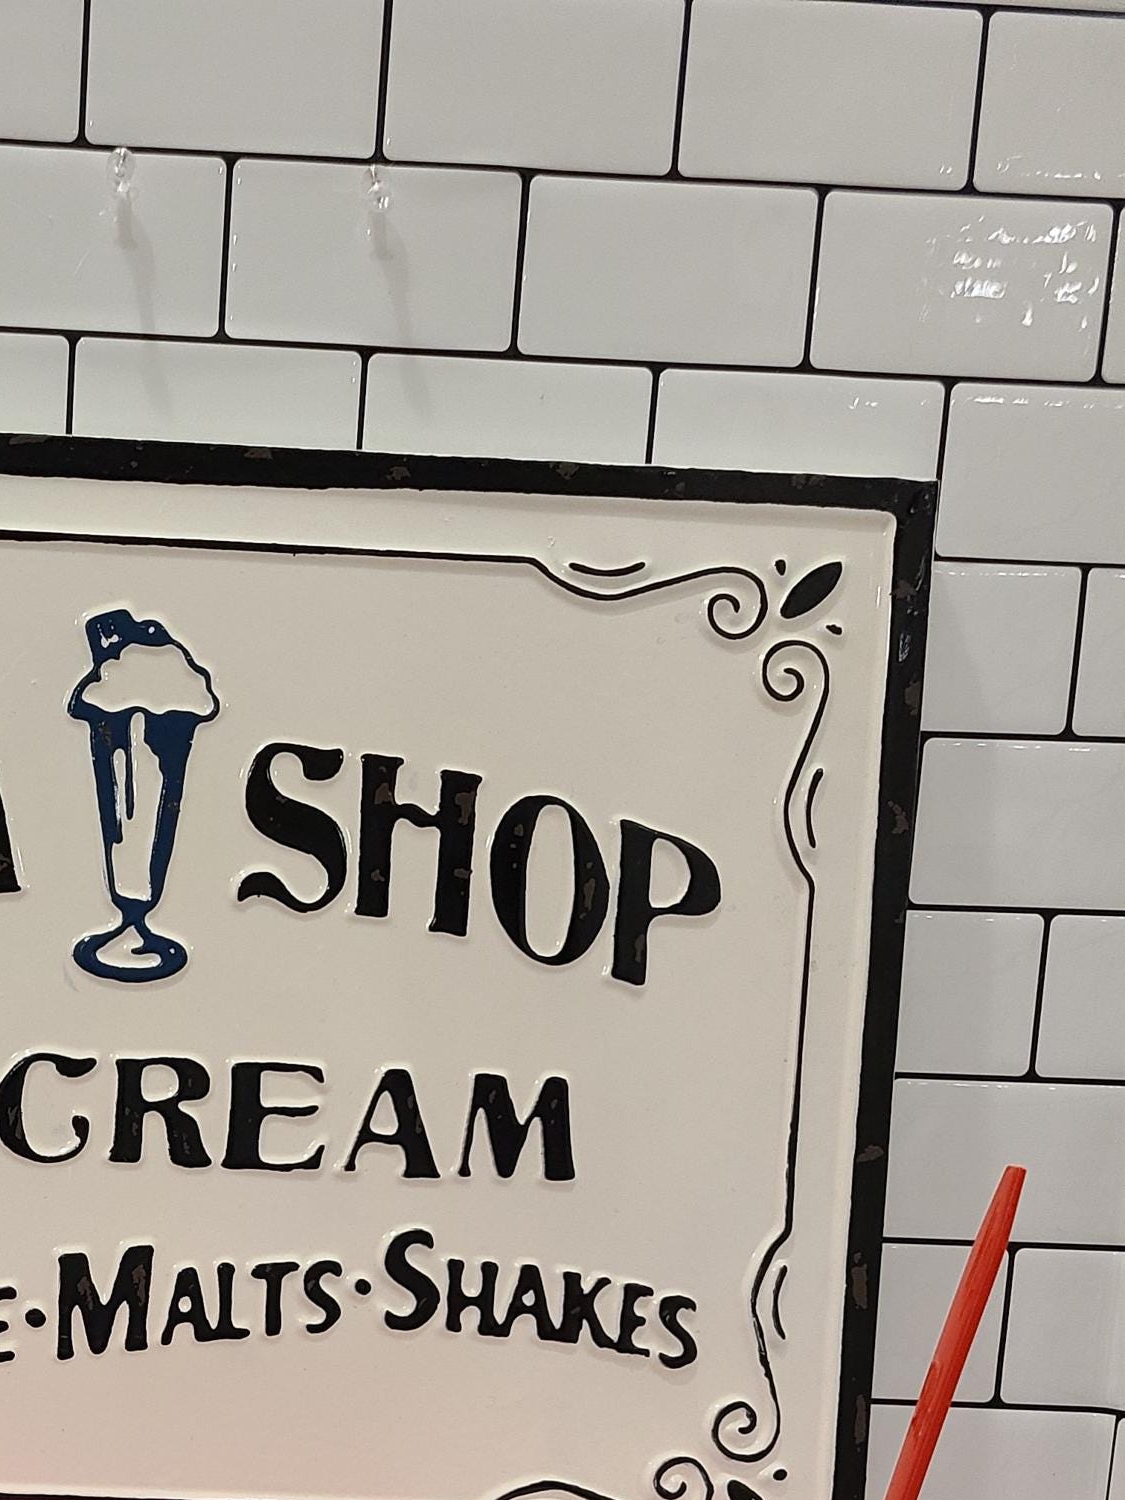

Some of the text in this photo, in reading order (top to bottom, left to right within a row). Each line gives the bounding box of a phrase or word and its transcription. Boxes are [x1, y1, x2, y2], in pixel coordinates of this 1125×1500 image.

[237, 742, 723, 986] SHOP
[56, 1244, 343, 1361] MALTS
[383, 1228, 698, 1370] SHAKES
